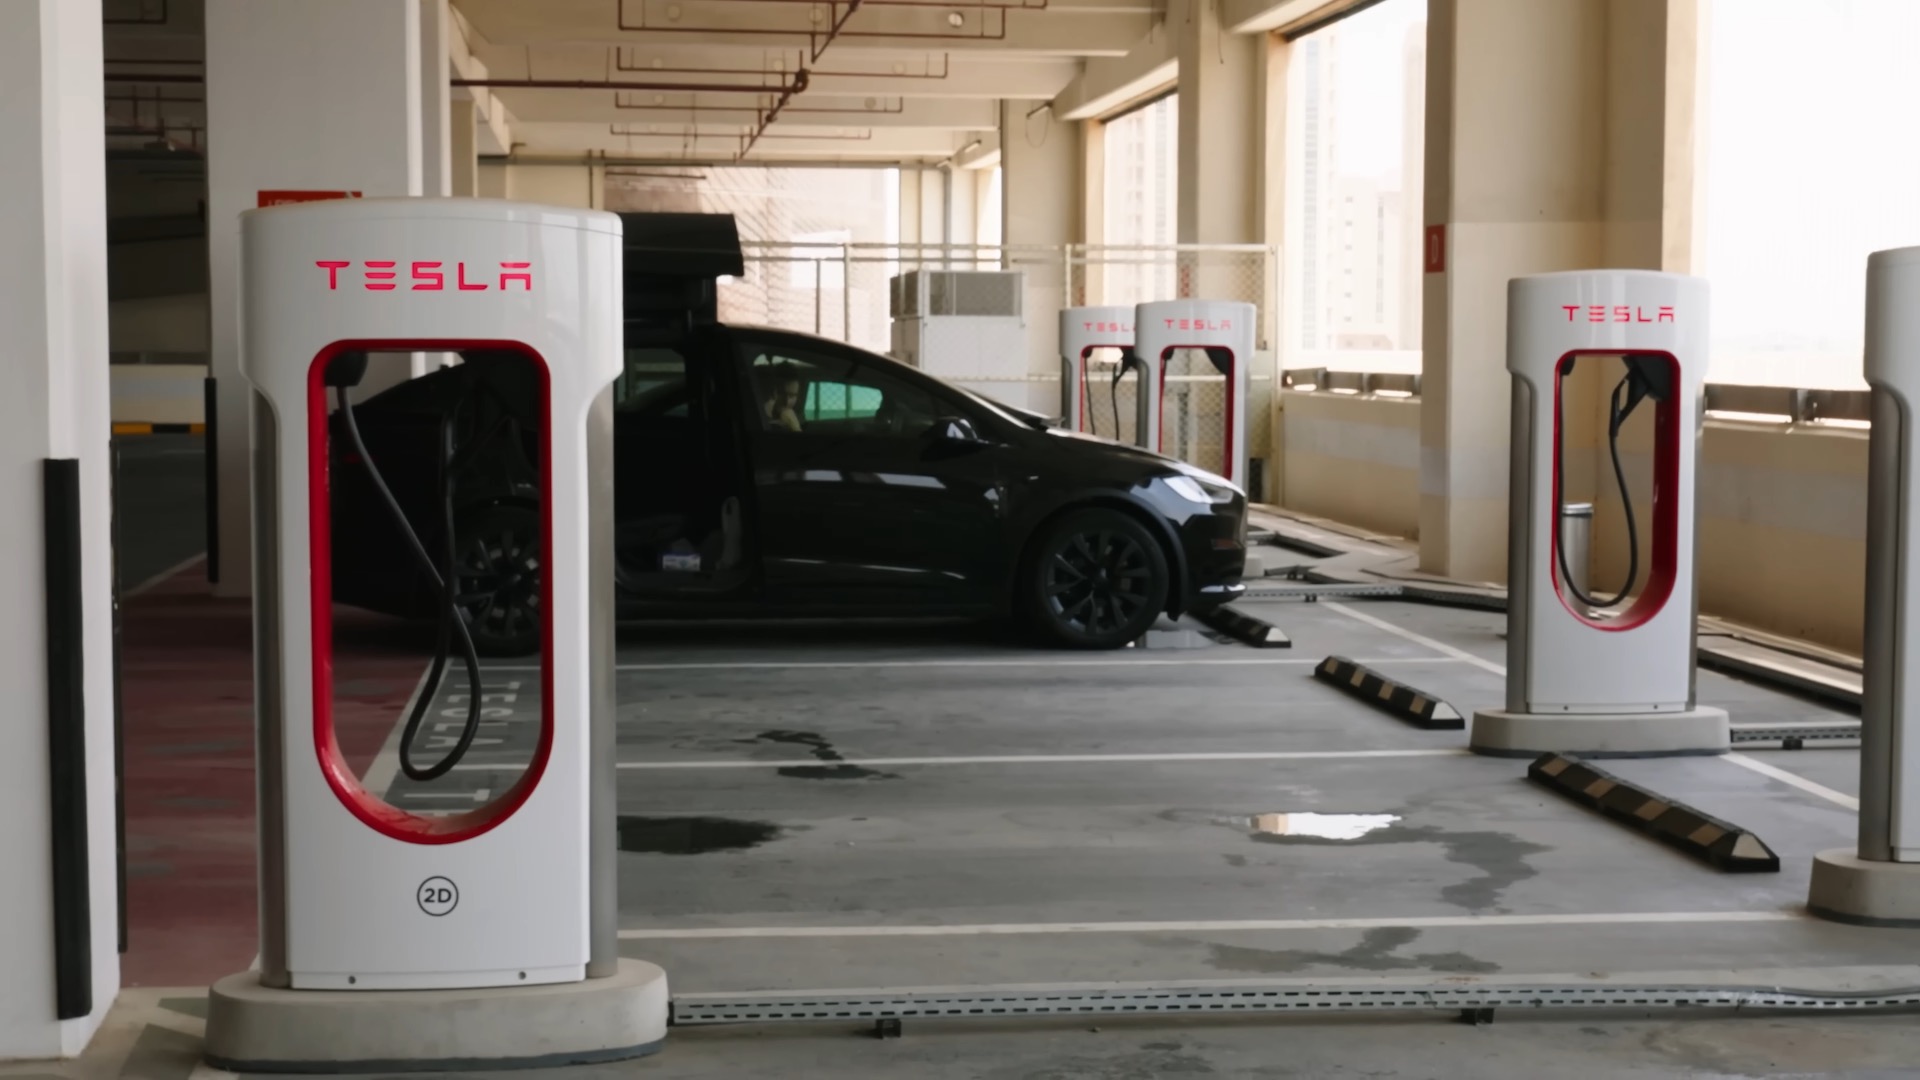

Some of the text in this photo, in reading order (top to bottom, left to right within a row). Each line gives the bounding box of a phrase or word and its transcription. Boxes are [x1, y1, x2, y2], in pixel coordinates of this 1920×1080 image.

[315, 261, 531, 290] TESLA
[1562, 305, 1674, 322] TESLA
[1083, 322, 1136, 332] TESL
[1163, 319, 1231, 331] TESLA
[424, 888, 452, 903] 2D
